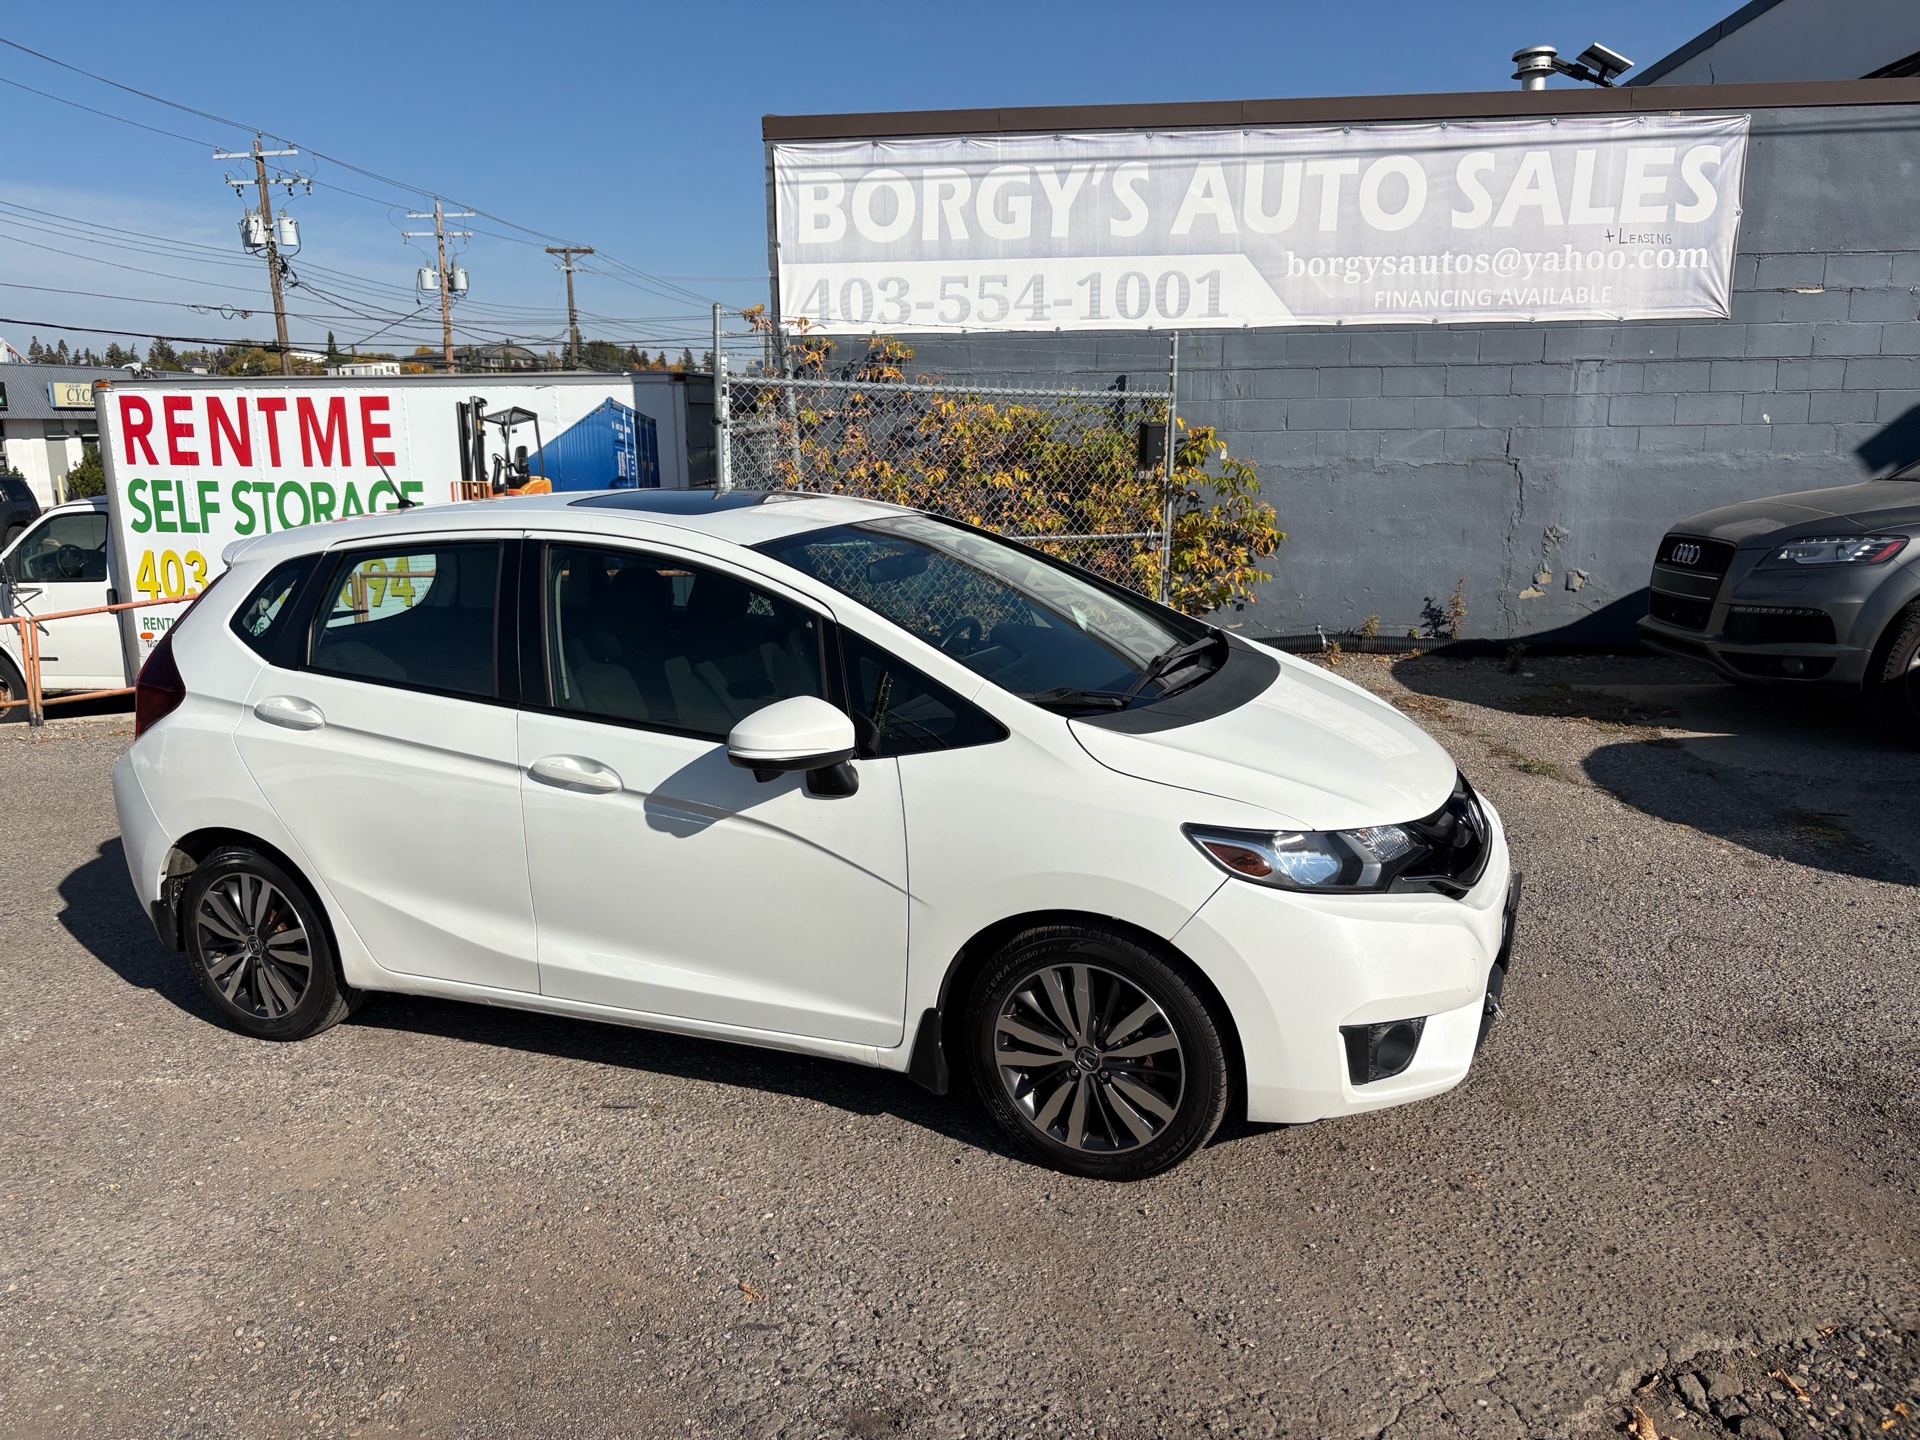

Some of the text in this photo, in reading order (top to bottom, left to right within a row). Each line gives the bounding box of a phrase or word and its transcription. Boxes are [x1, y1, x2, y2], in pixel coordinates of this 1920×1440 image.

[797, 144, 1723, 244] BORGY'S AUTO SALES
[1285, 244, 1710, 284] borgysautos@yahoo.com
[800, 269, 1230, 326] 403-554-1001
[1374, 284, 1613, 308] FINANCING AVAILABLE
[127, 478, 220, 534] SELF
[143, 617, 177, 631] RENT
